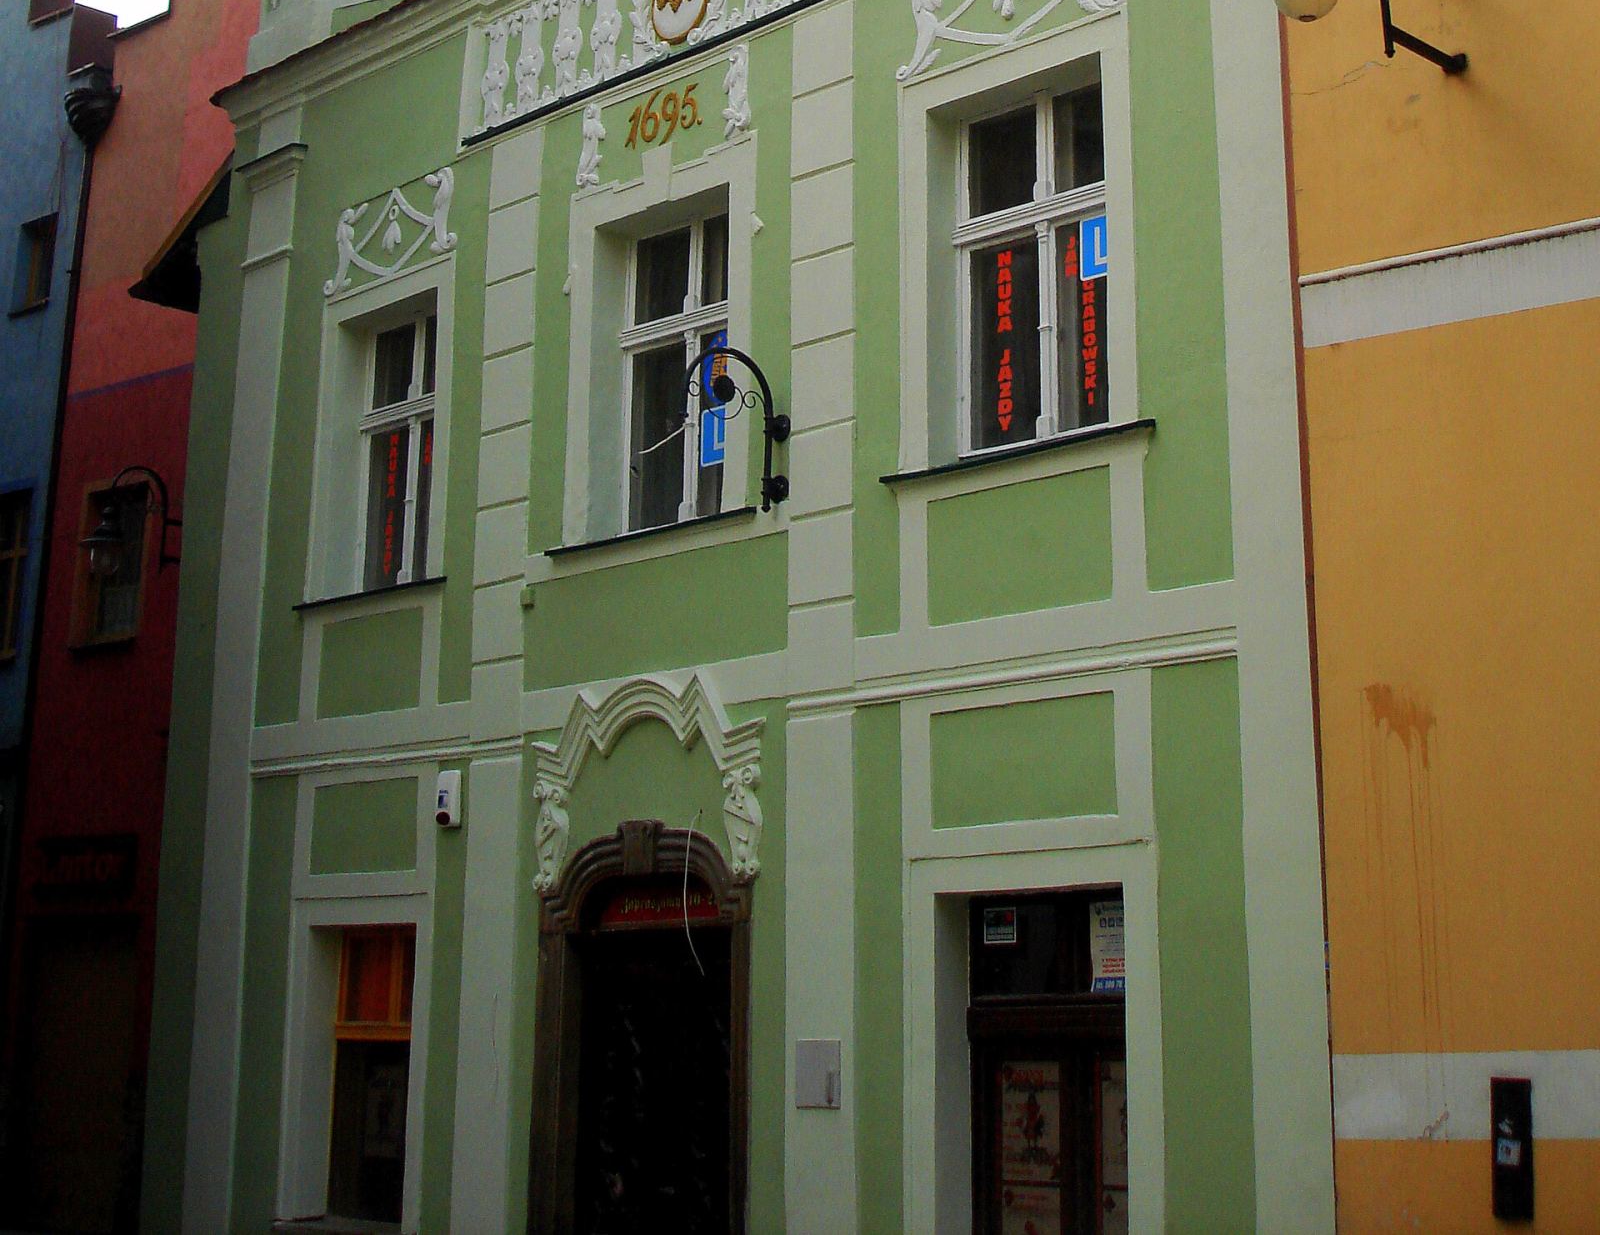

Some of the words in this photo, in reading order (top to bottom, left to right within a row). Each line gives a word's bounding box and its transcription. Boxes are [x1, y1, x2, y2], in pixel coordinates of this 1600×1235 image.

[997, 250, 1013, 333] NAUKA
[1064, 235, 1078, 278] JAN
[1082, 279, 1098, 405] GRABOWSKI
[997, 349, 1013, 431] JAZDY
[386, 433, 399, 498] NAUKA
